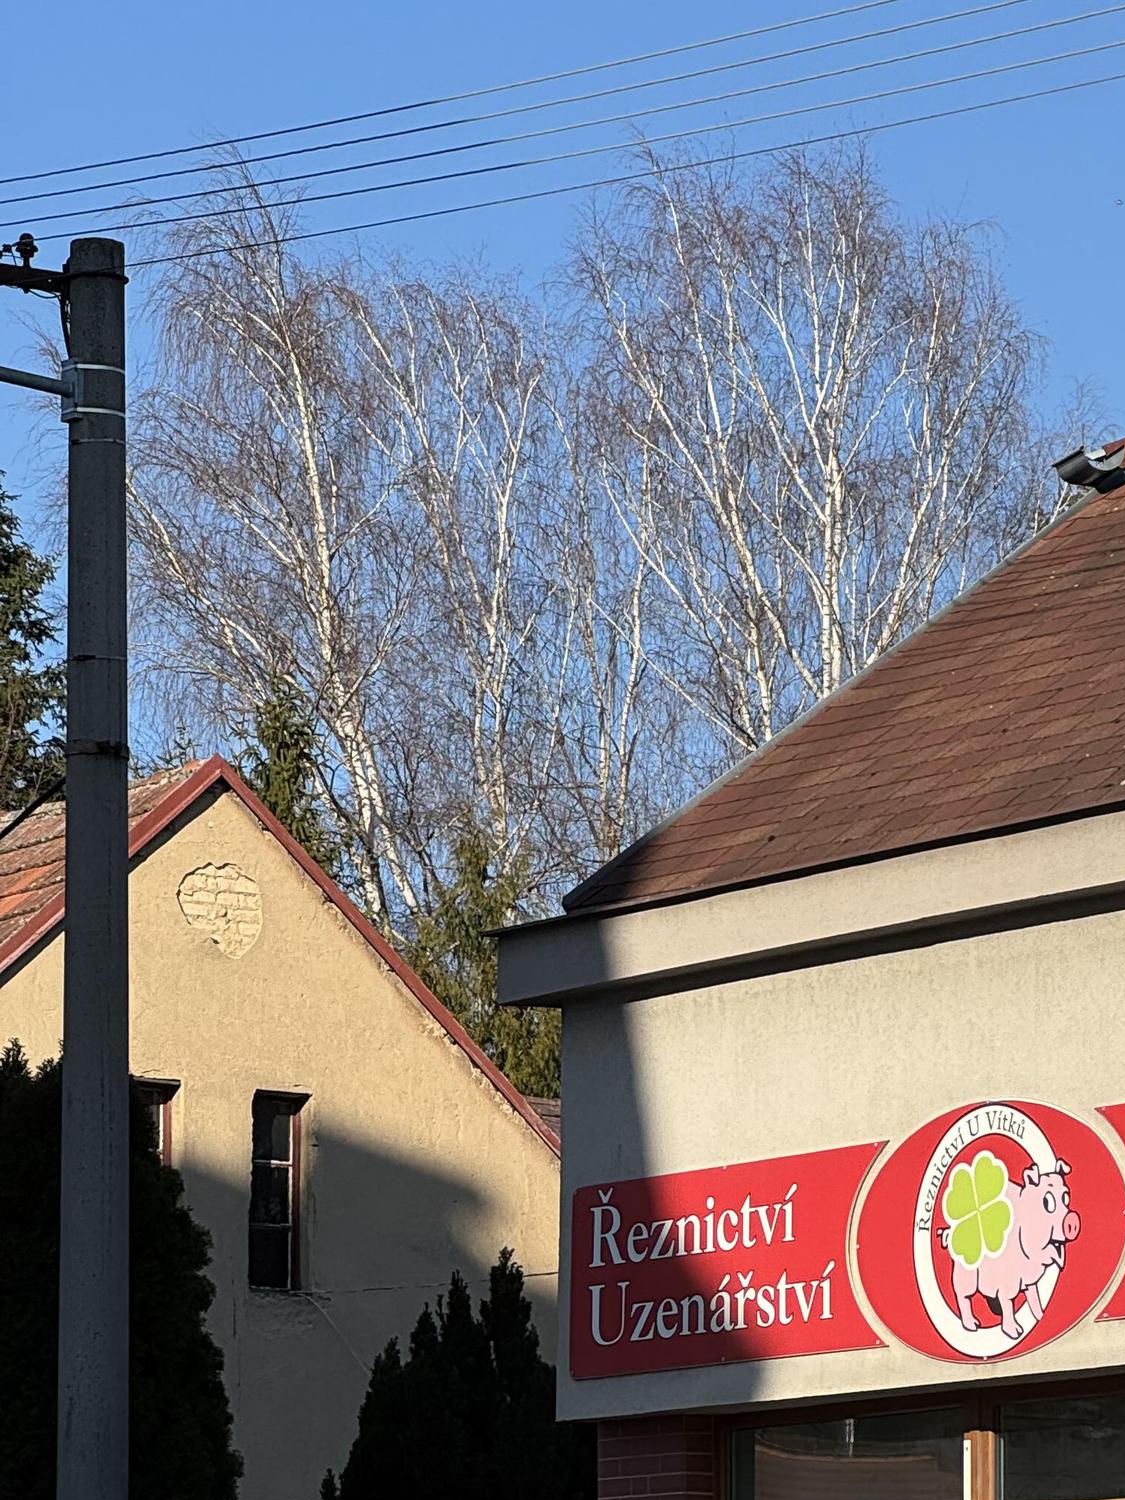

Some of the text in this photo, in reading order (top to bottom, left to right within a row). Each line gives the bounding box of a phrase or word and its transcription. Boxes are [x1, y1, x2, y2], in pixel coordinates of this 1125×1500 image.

[916, 1110, 1026, 1232] Řeznictví U Vítků
[588, 1183, 799, 1269] Řeznictví
[588, 1259, 836, 1346] Uzenářství
